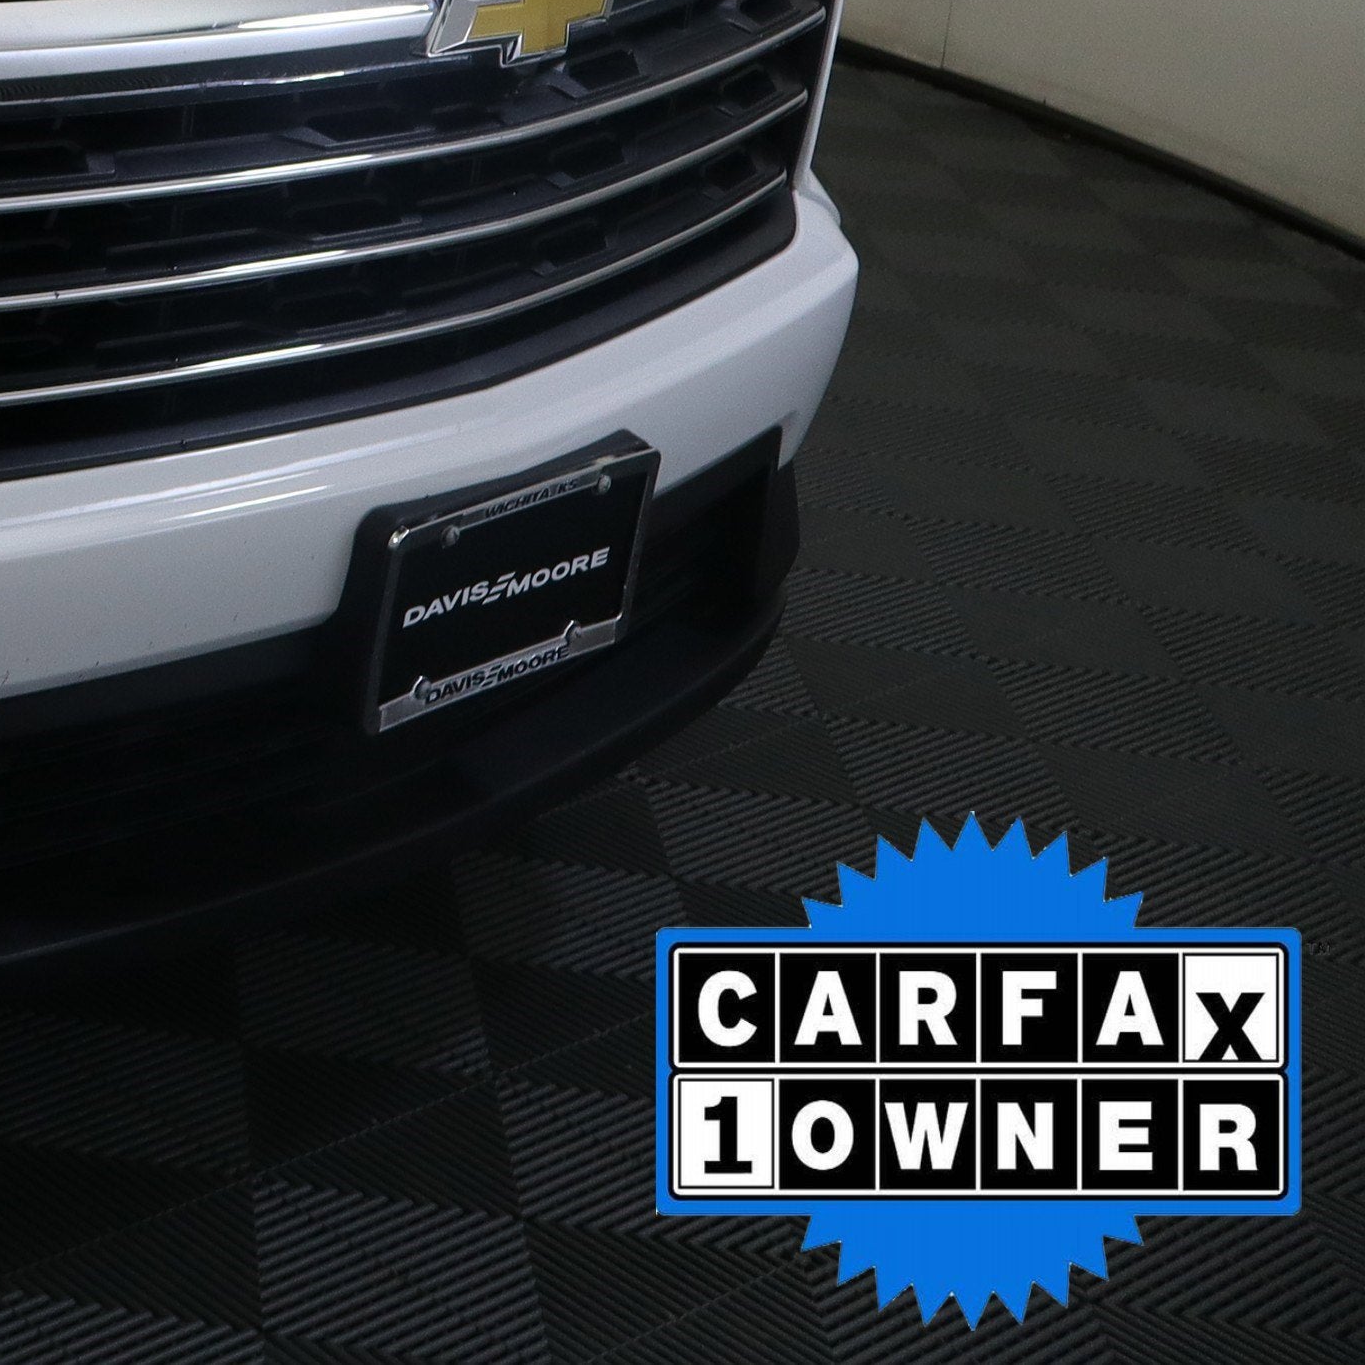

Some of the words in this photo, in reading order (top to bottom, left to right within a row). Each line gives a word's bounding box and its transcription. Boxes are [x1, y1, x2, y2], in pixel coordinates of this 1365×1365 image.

[402, 580, 490, 629] DAVIS
[505, 546, 611, 599] MOORE
[424, 670, 487, 705] DAVIS
[496, 646, 570, 683] MOORE
